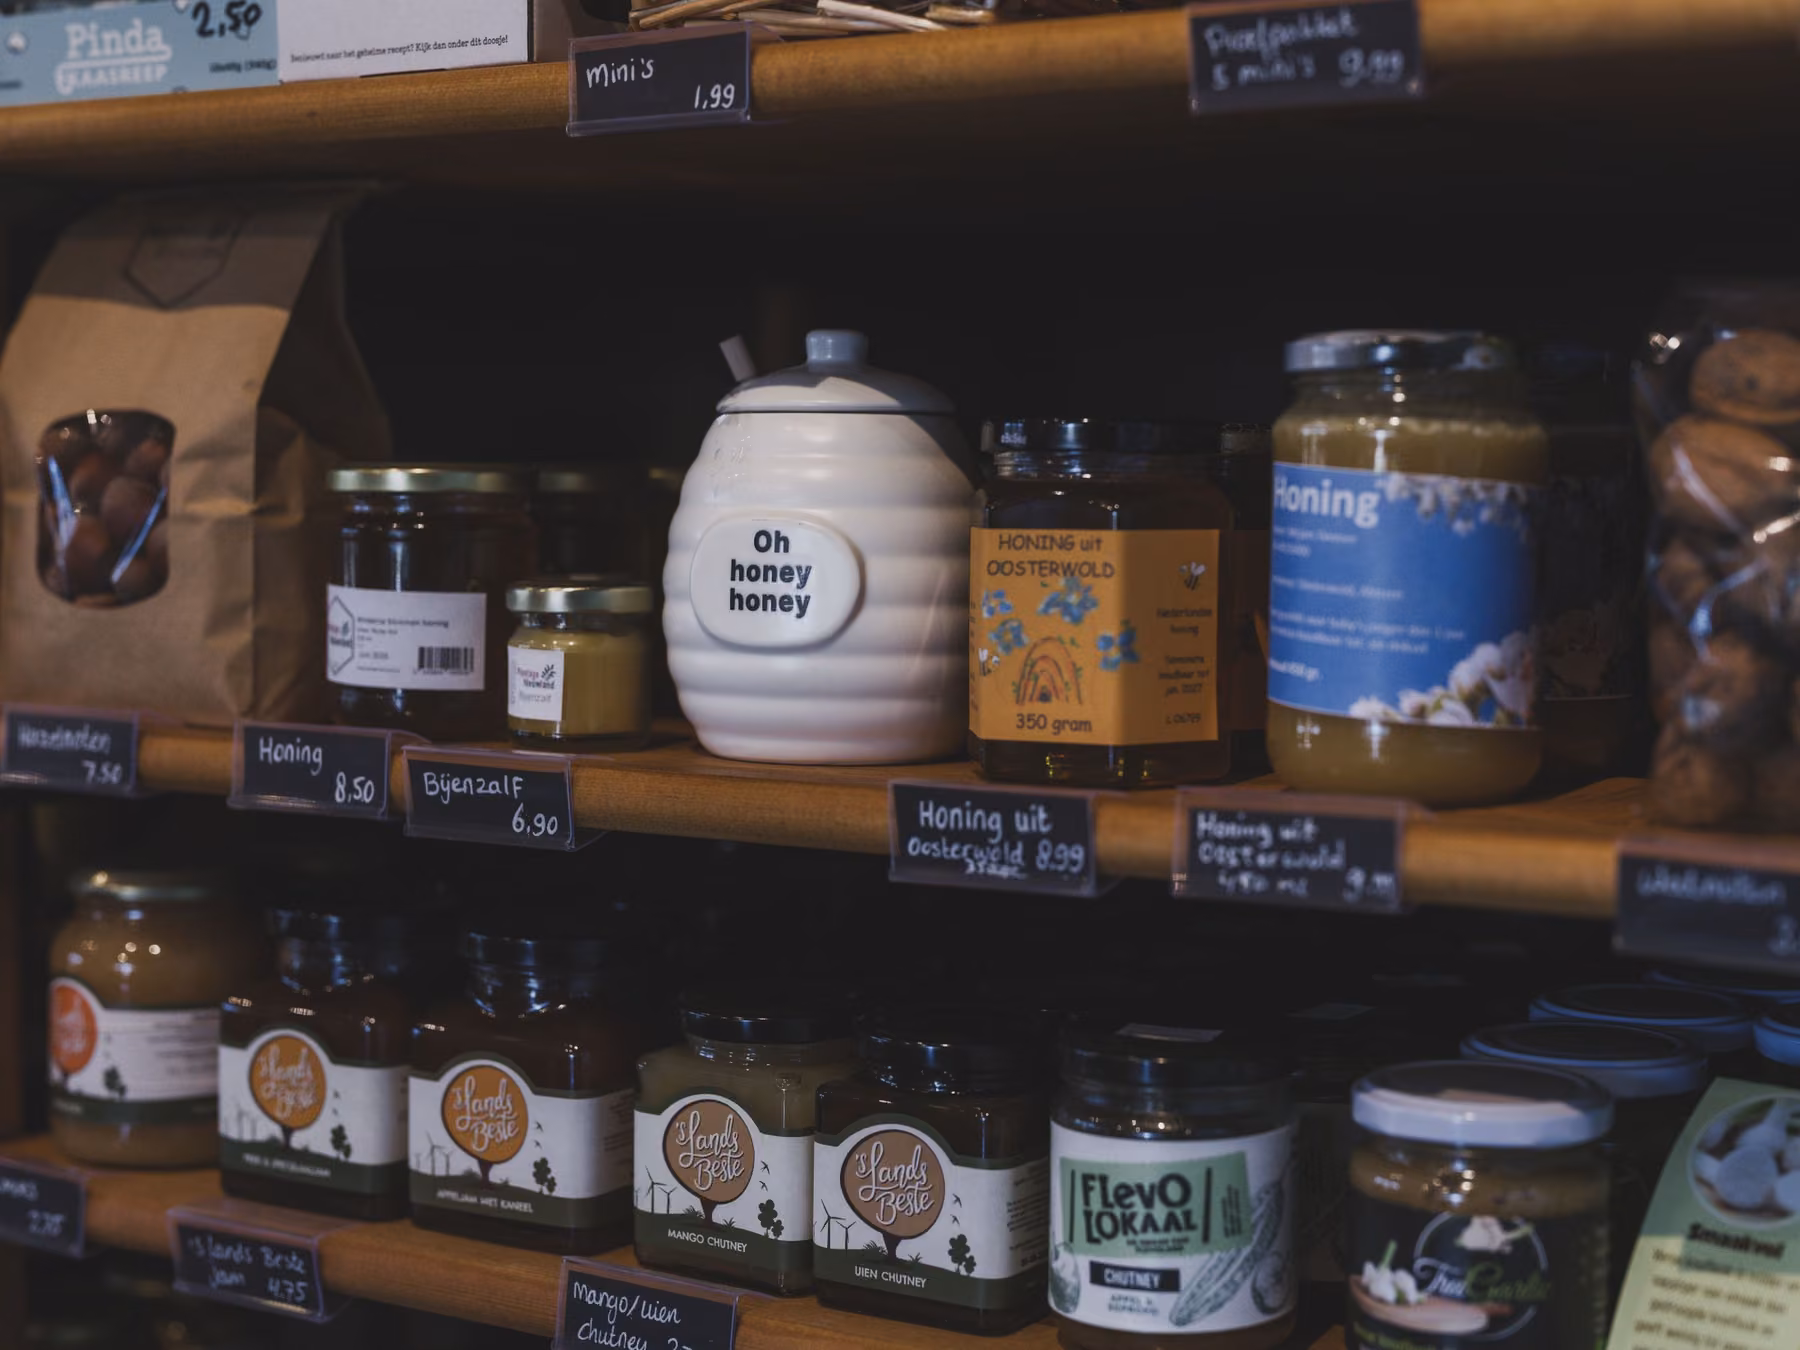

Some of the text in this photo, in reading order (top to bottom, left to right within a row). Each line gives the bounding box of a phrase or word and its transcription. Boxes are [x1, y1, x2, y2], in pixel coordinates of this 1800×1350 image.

[65, 17, 165, 59] Pinda
[415, 42, 431, 53] Kijk
[433, 41, 446, 50] dan
[448, 38, 469, 49] onder
[470, 37, 482, 46] dit
[483, 34, 508, 46] doosje!
[753, 529, 790, 553] Oh
[998, 534, 1104, 551] HONING uit
[730, 558, 812, 590] honey
[986, 559, 1116, 578] OOSTERWOLD
[729, 587, 811, 619] honey
[1016, 713, 1092, 736] 350 gram
[259, 737, 323, 776] Honing
[512, 802, 558, 837] 6,90
[919, 800, 1053, 844] Honing uit
[1197, 811, 1274, 849] Honing
[679, 1110, 740, 1168] Lands
[693, 1150, 745, 1191] Beste
[859, 1141, 929, 1202] Lands
[500, 1200, 534, 1213] KANEEL
[875, 1183, 935, 1226] Beste
[667, 1228, 748, 1253] MANGO CHUTNEY
[1082, 1208, 1199, 1245] LOKAAL
[854, 1265, 928, 1289] UIEN CHUTNEY
[1103, 1268, 1162, 1288] CHUTNEY
